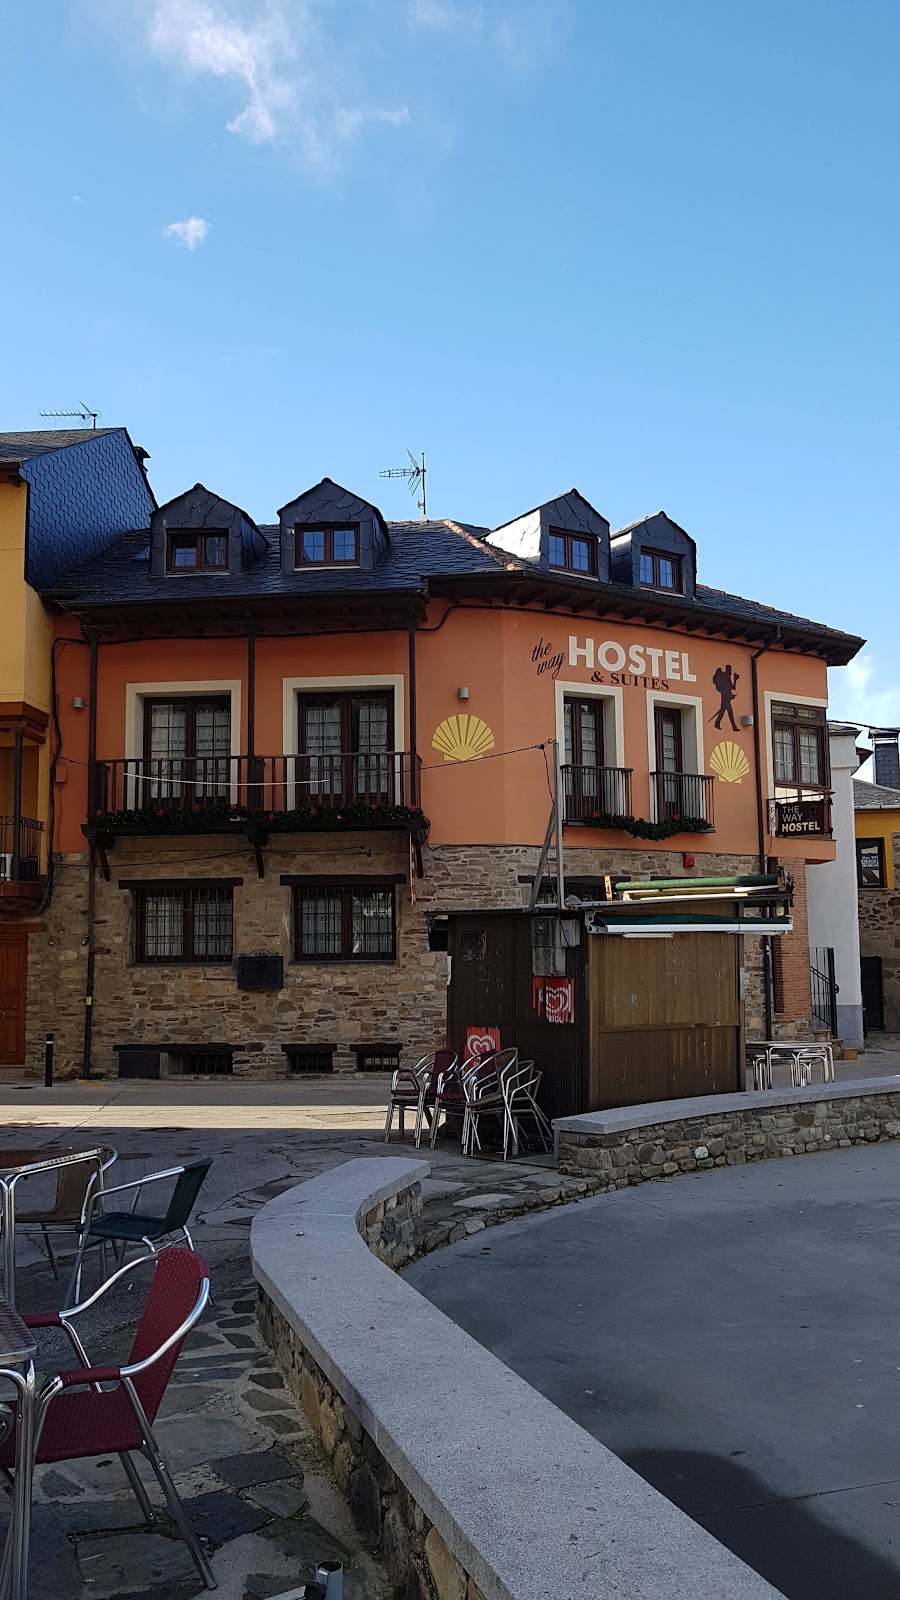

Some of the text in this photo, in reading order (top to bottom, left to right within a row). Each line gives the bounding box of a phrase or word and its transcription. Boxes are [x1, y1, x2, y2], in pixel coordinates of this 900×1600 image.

[531, 637, 552, 662] the
[568, 635, 697, 682] HOSTEL
[537, 651, 566, 679] way
[590, 671, 670, 691] & SUITES
[782, 805, 800, 813] THE
[782, 813, 803, 822] WAY
[782, 821, 820, 832] HOSTEL
